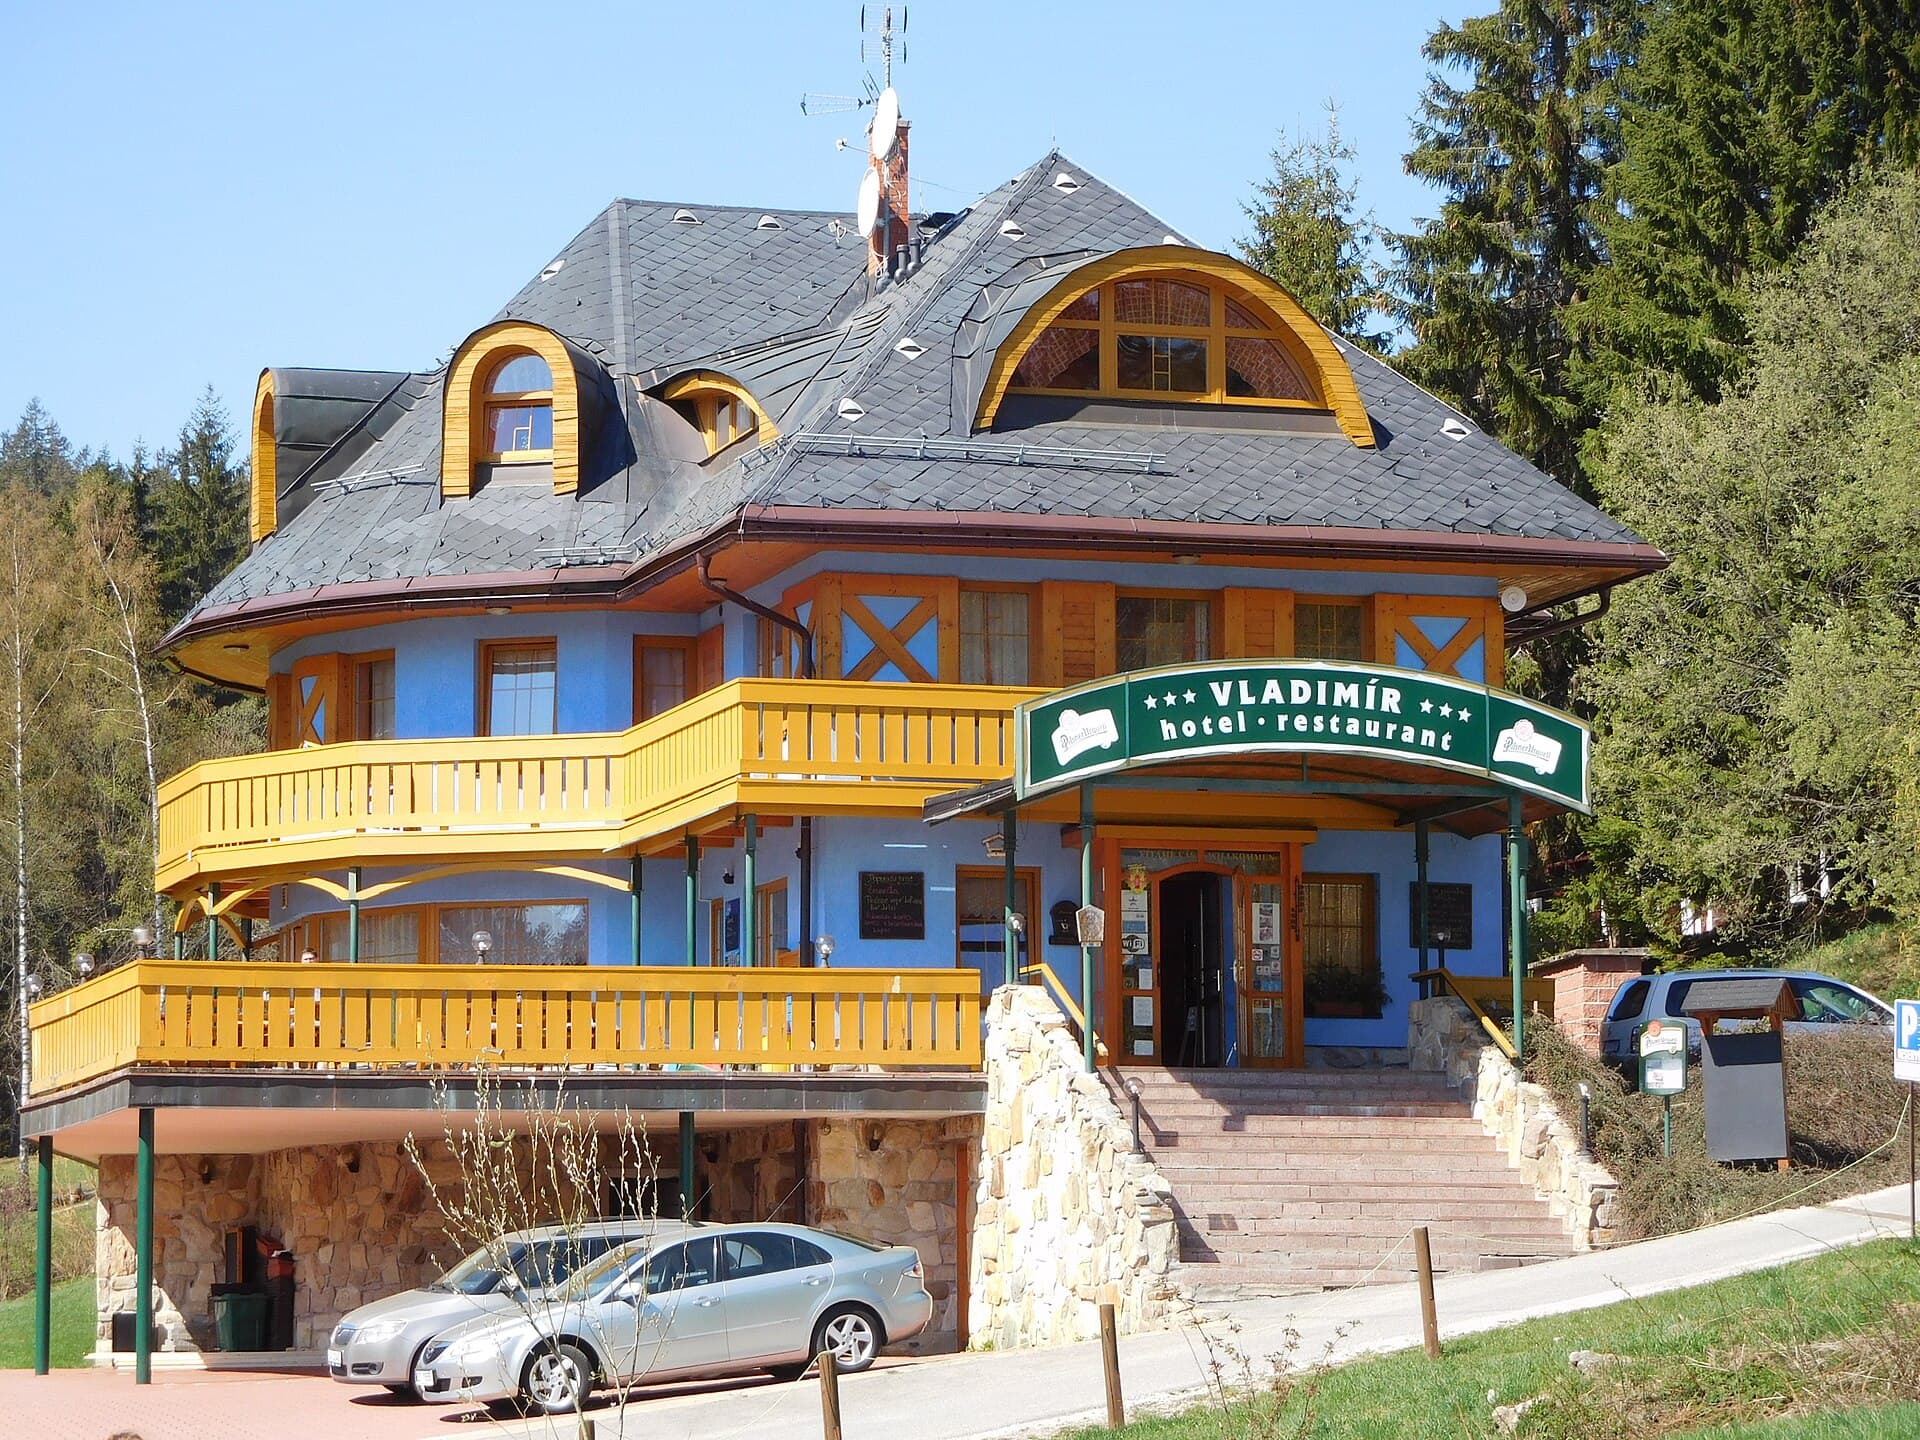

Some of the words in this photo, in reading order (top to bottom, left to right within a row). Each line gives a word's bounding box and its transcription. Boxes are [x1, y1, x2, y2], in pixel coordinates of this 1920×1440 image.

[1208, 678, 1401, 714] VLADIMÍR
[1159, 710, 1246, 741] hotel
[1277, 712, 1452, 751] restaurant
[1901, 1004, 1918, 1048] P
